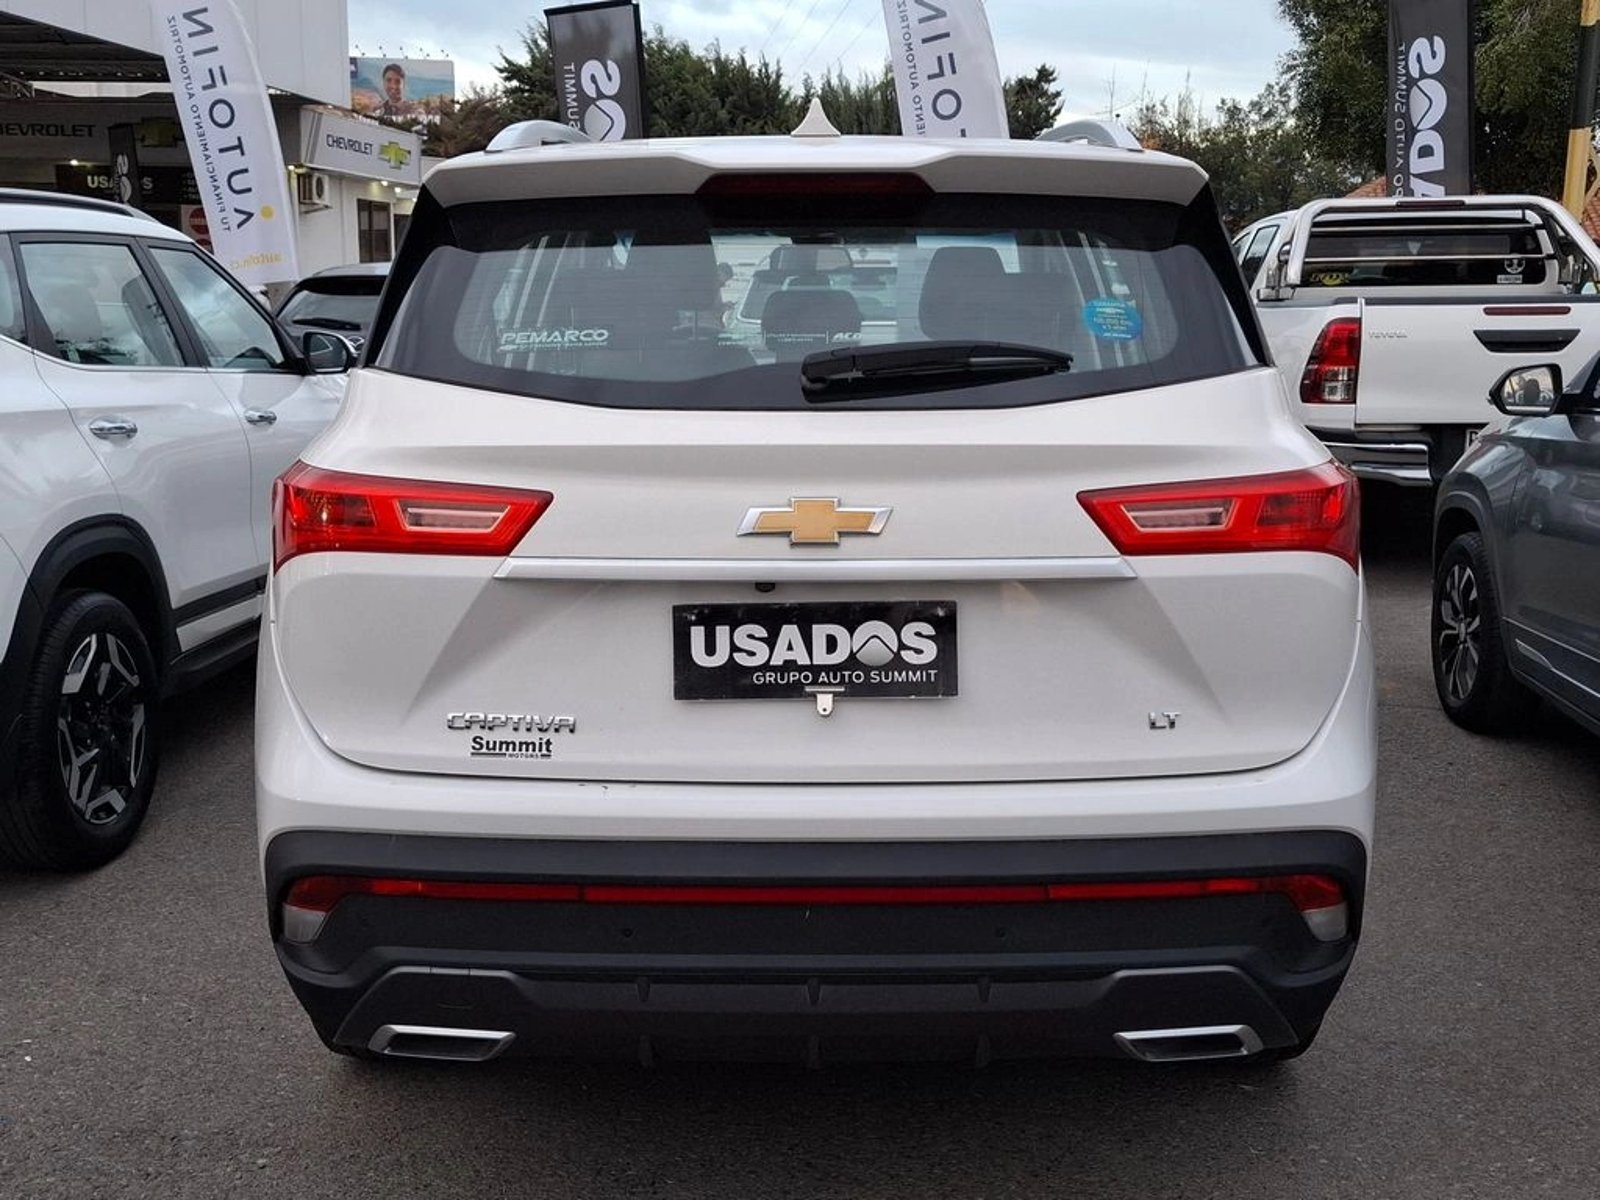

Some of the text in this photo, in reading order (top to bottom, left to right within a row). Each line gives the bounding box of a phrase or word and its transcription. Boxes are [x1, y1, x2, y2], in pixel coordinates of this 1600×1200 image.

[326, 134, 373, 155] CHEVROLET
[501, 329, 609, 345] PEMARCO
[690, 620, 938, 667] USADOS
[753, 670, 937, 685] GRUPO AUTO SUMMIT
[447, 712, 576, 733] CAPTIVA
[1149, 711, 1181, 730] LT
[471, 735, 552, 753] Summit
